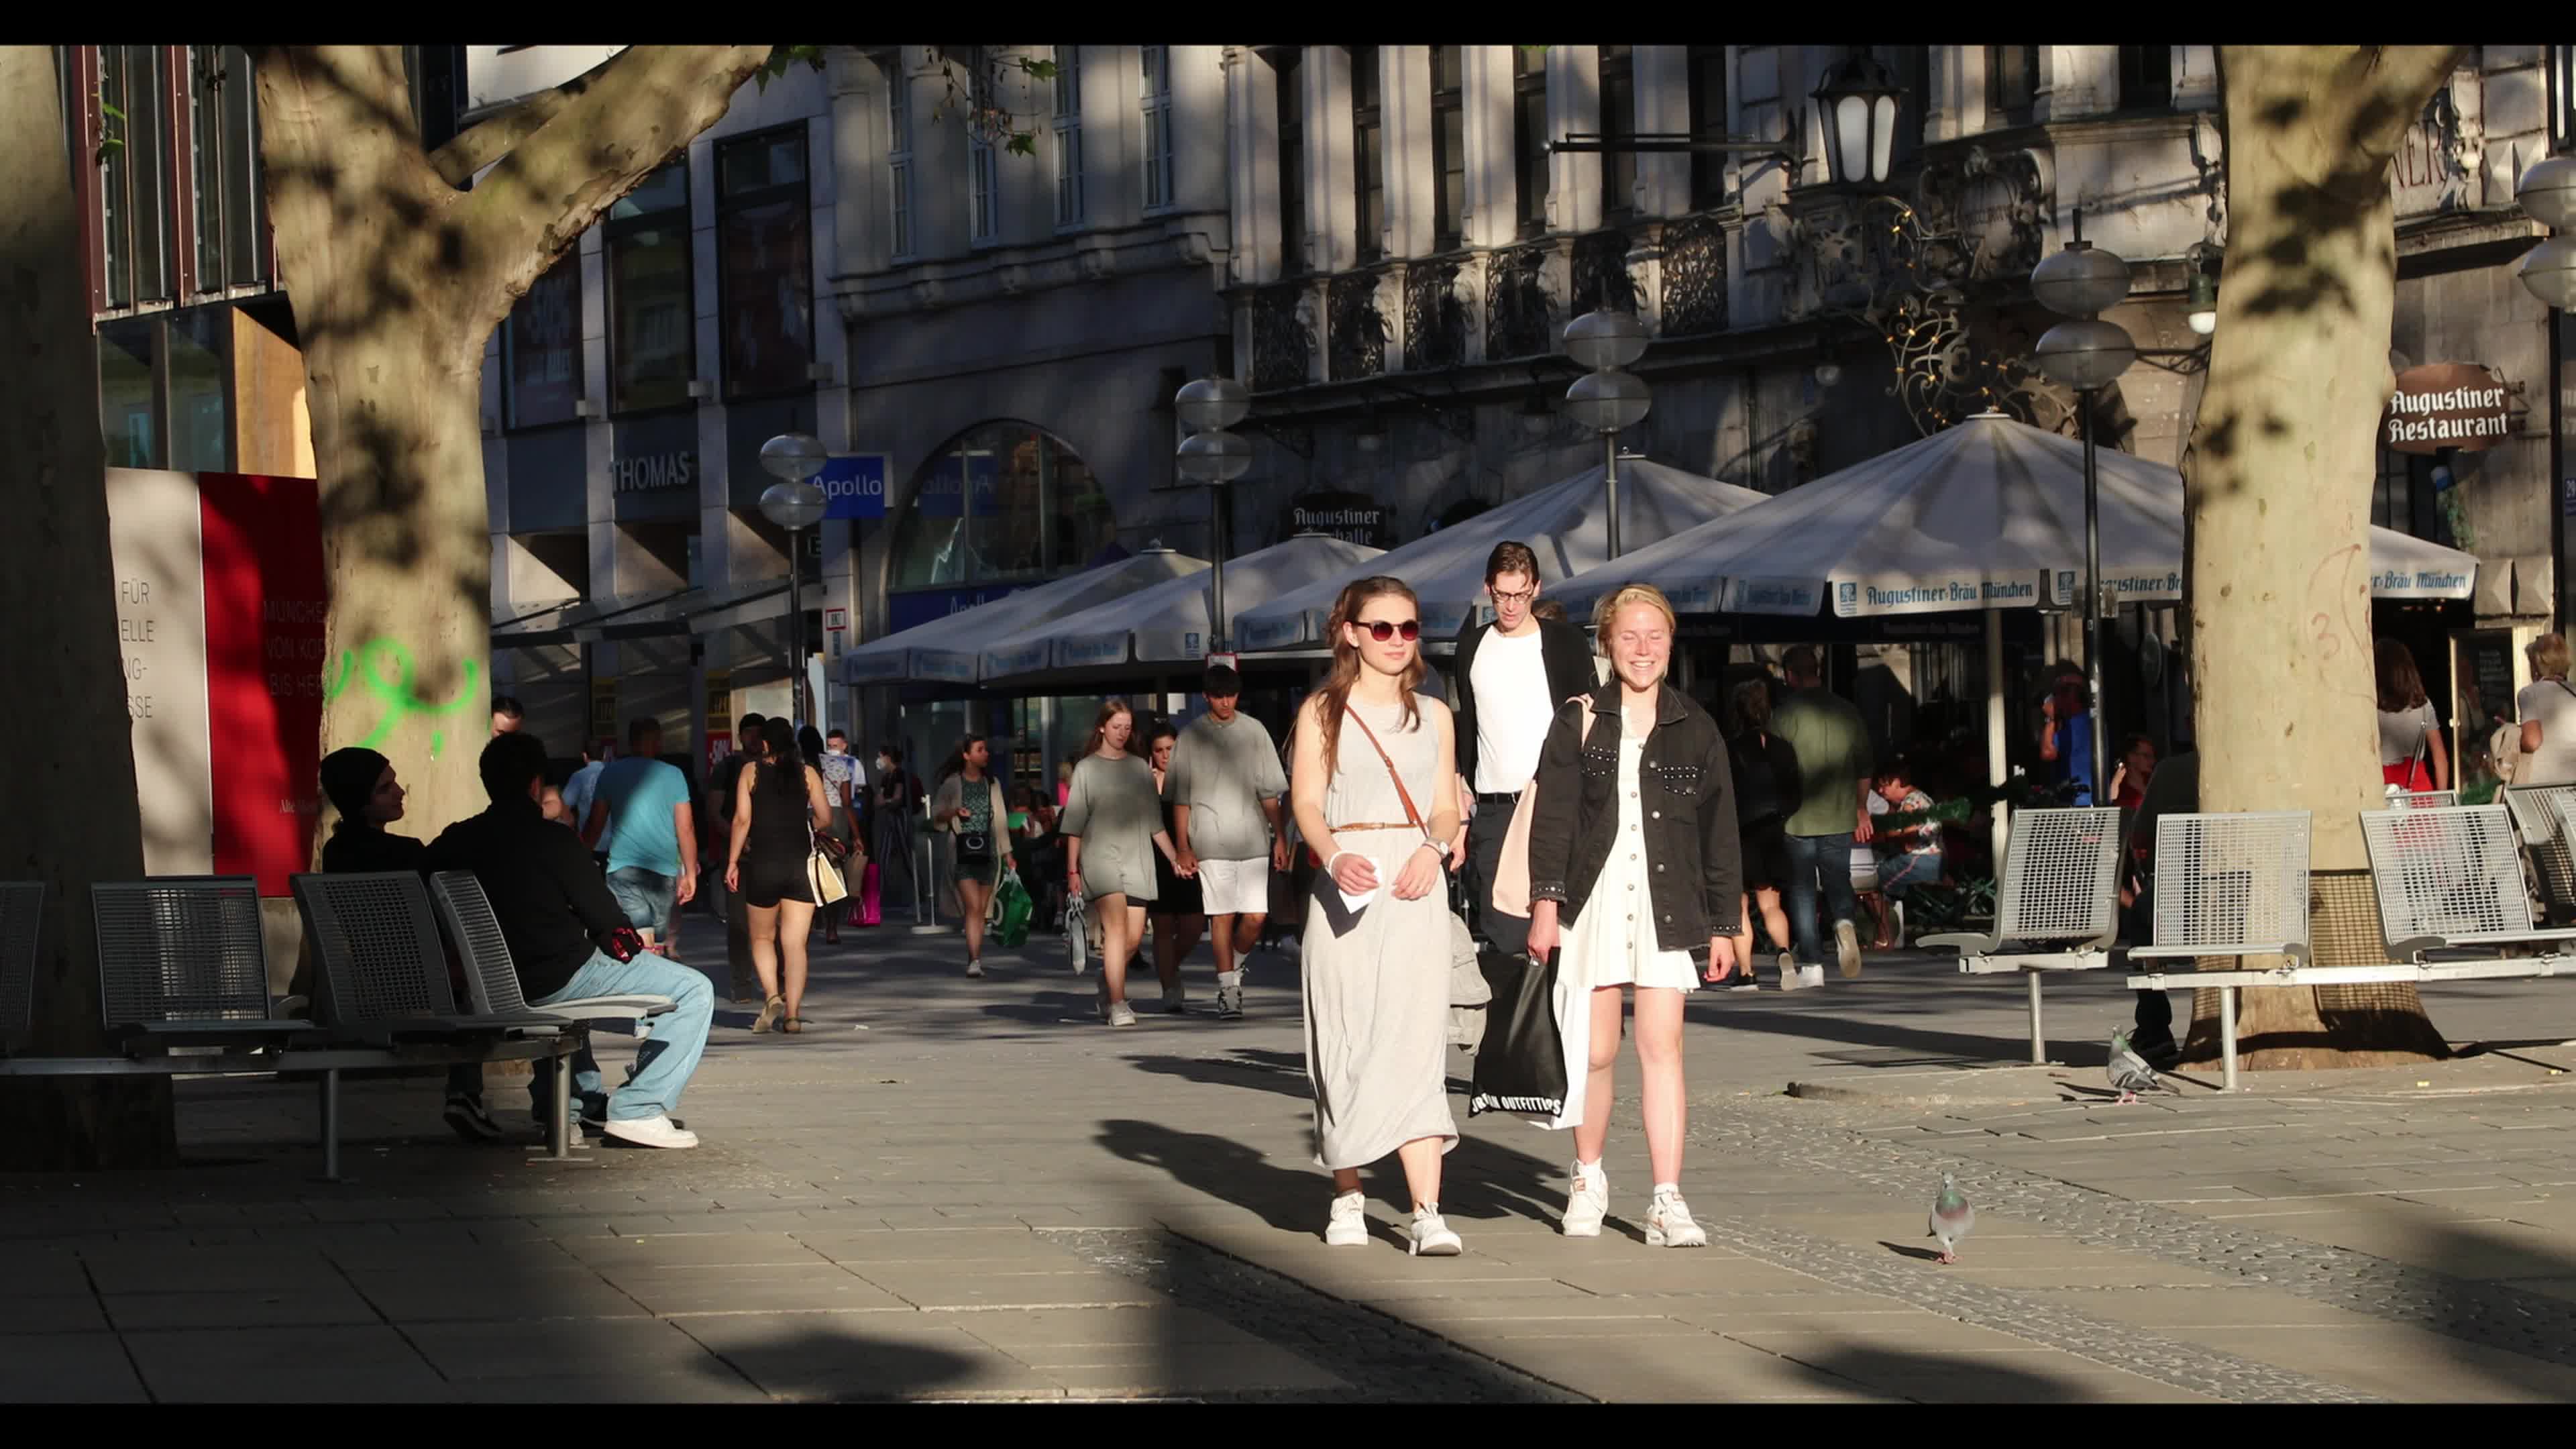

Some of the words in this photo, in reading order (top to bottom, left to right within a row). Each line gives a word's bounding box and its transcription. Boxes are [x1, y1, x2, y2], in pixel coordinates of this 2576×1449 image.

[2390, 386, 2504, 417] Augustiner
[2388, 412, 2507, 443] Restaurant
[611, 451, 690, 493] THOMAS
[814, 474, 883, 500] Apollo
[1293, 507, 1380, 527] Augustiner
[121, 579, 150, 604] FÜR
[1981, 580, 2033, 599] München
[2416, 571, 2466, 588] München
